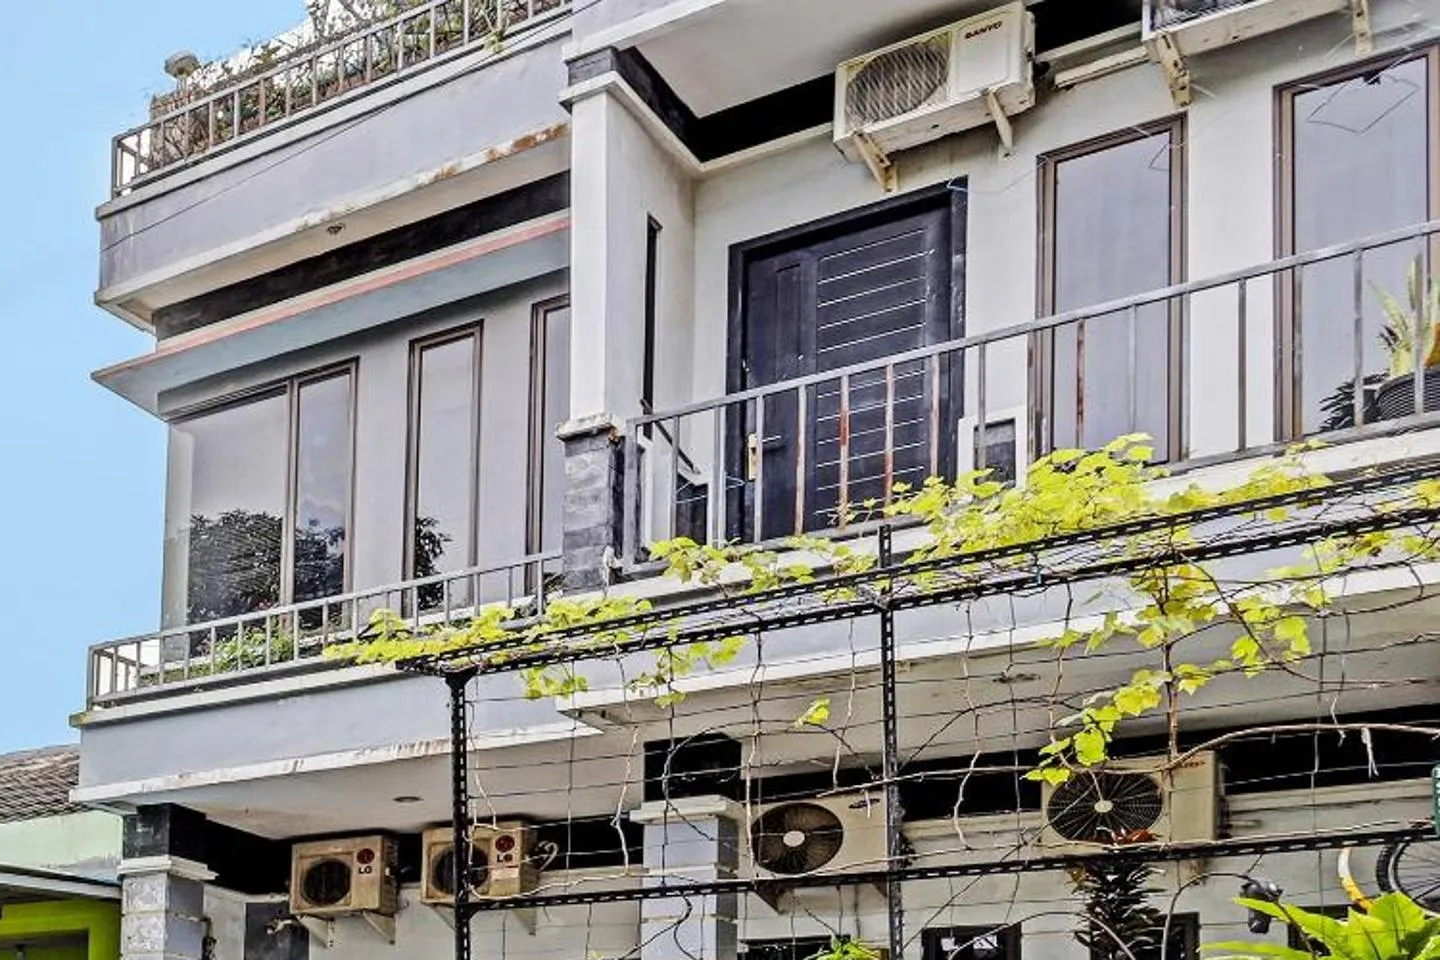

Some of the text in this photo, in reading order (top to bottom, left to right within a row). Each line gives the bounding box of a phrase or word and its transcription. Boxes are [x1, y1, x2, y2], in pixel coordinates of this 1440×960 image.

[964, 20, 1003, 39] SANYO
[496, 854, 513, 863] LG
[358, 865, 373, 875] LG
